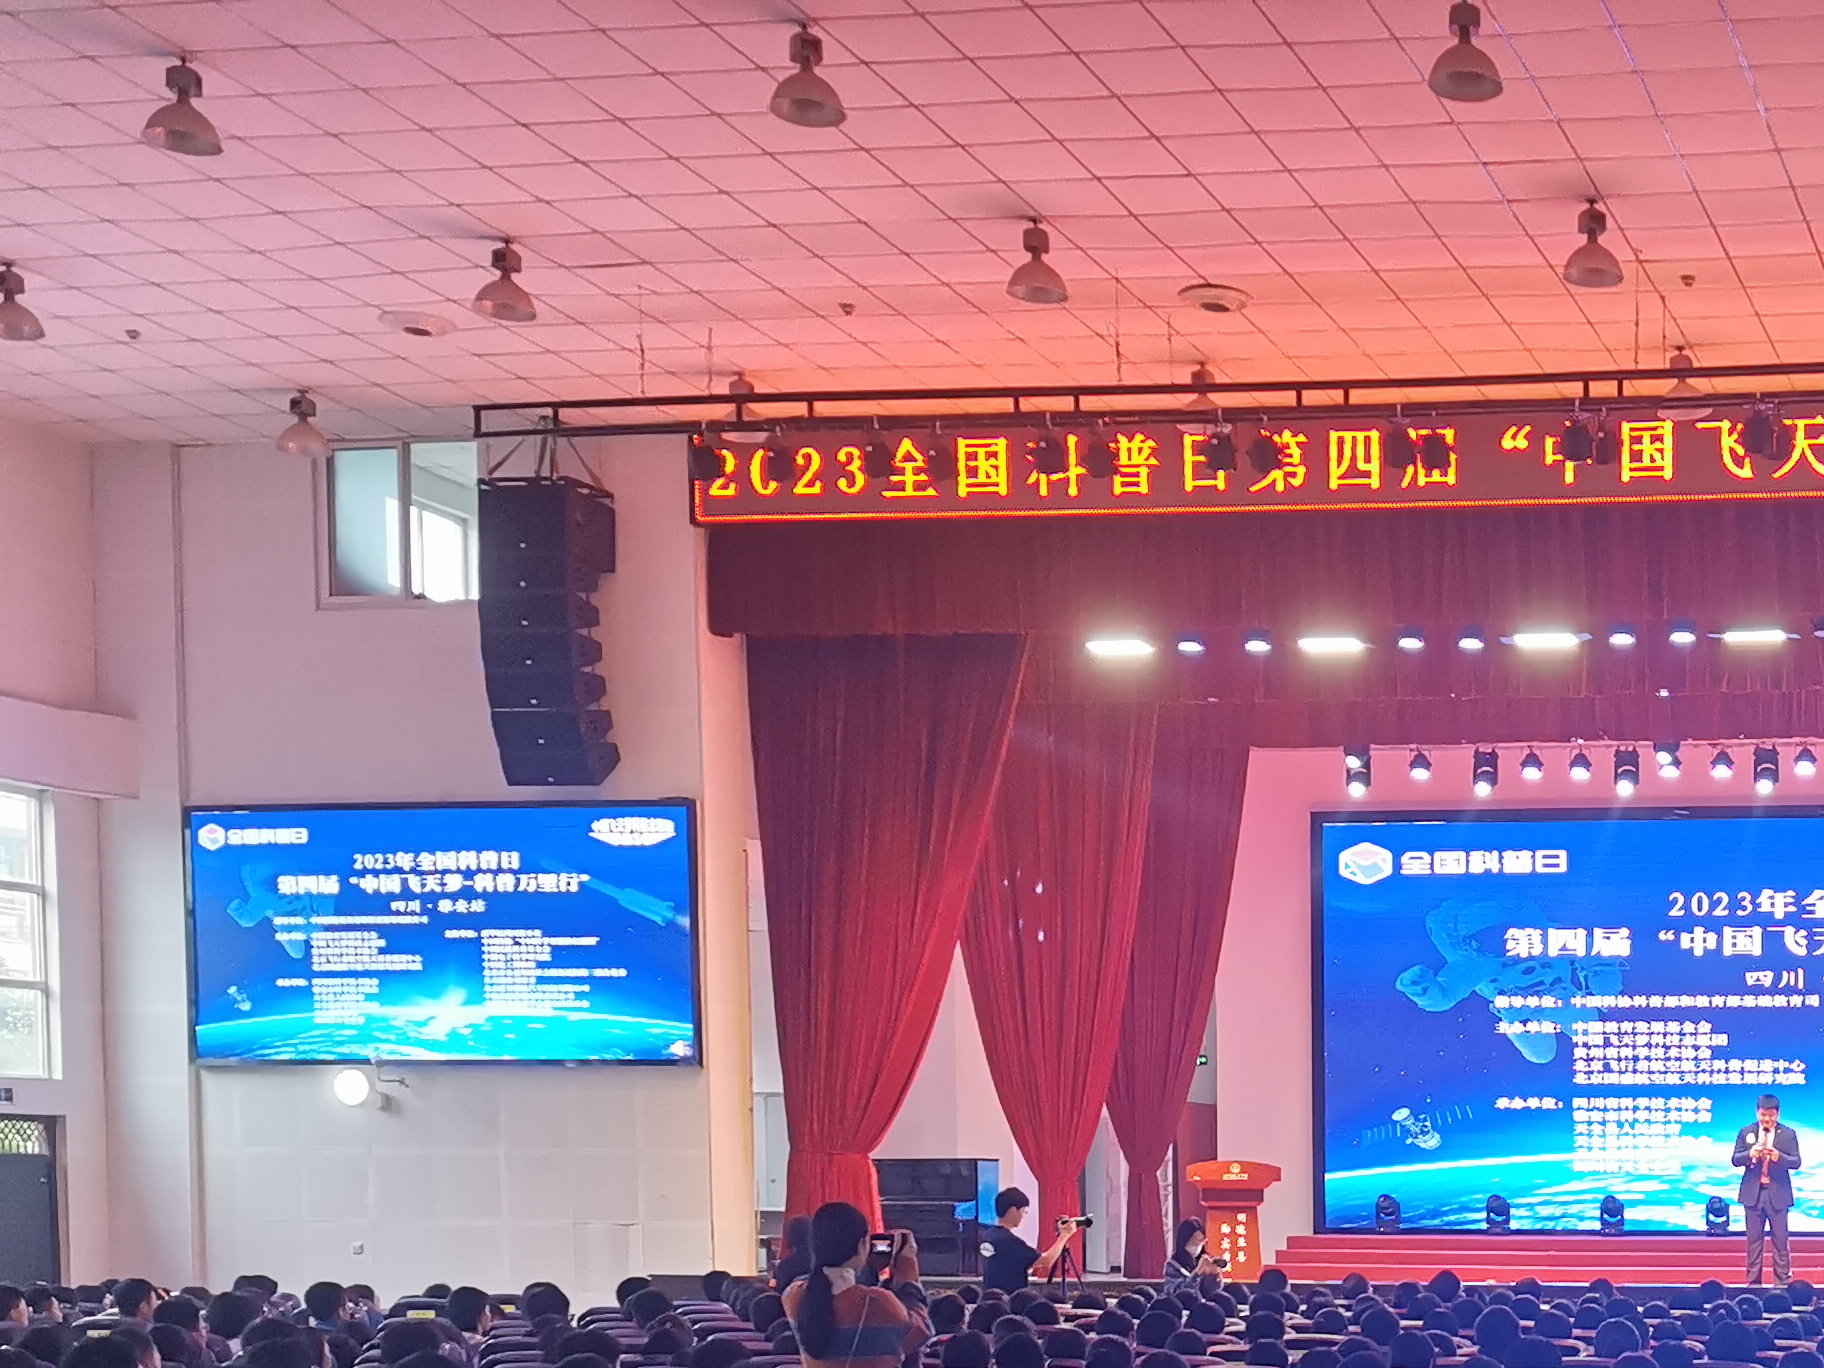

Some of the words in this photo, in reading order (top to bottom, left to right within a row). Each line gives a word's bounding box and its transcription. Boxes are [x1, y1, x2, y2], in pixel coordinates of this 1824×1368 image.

[353, 851, 520, 871] 2023年全国科普日
[1400, 849, 1567, 874] 全国科普日
